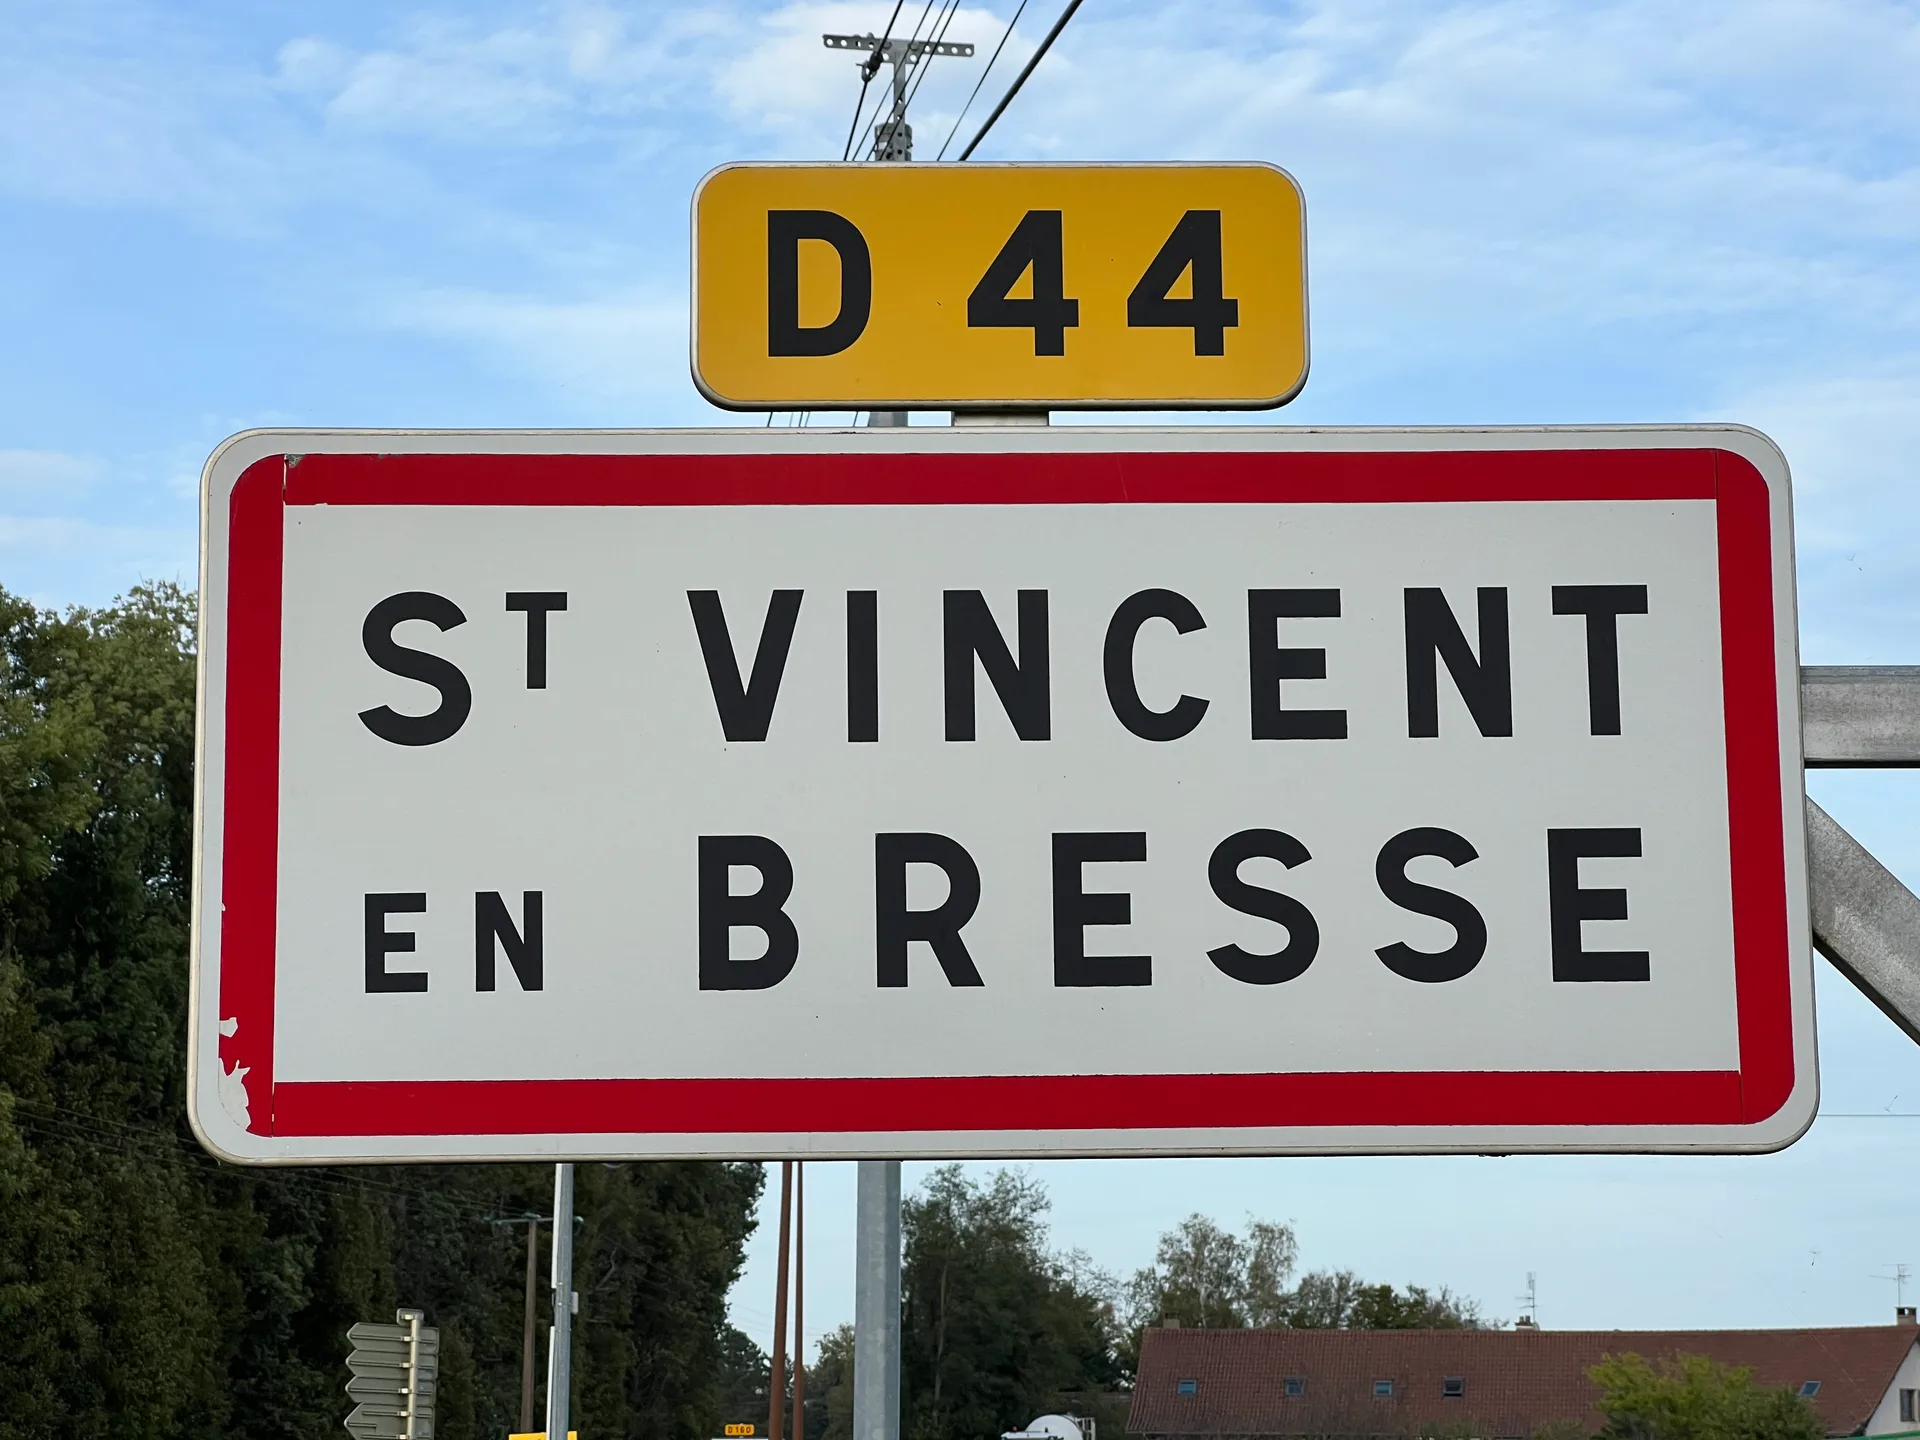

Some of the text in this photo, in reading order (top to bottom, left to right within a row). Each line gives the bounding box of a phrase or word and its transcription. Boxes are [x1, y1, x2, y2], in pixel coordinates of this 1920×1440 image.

[767, 209, 1240, 358] D 44
[686, 584, 1650, 743] VINCENT
[364, 827, 1652, 994] EN BRESSE
[735, 1426, 752, 1434] 160
